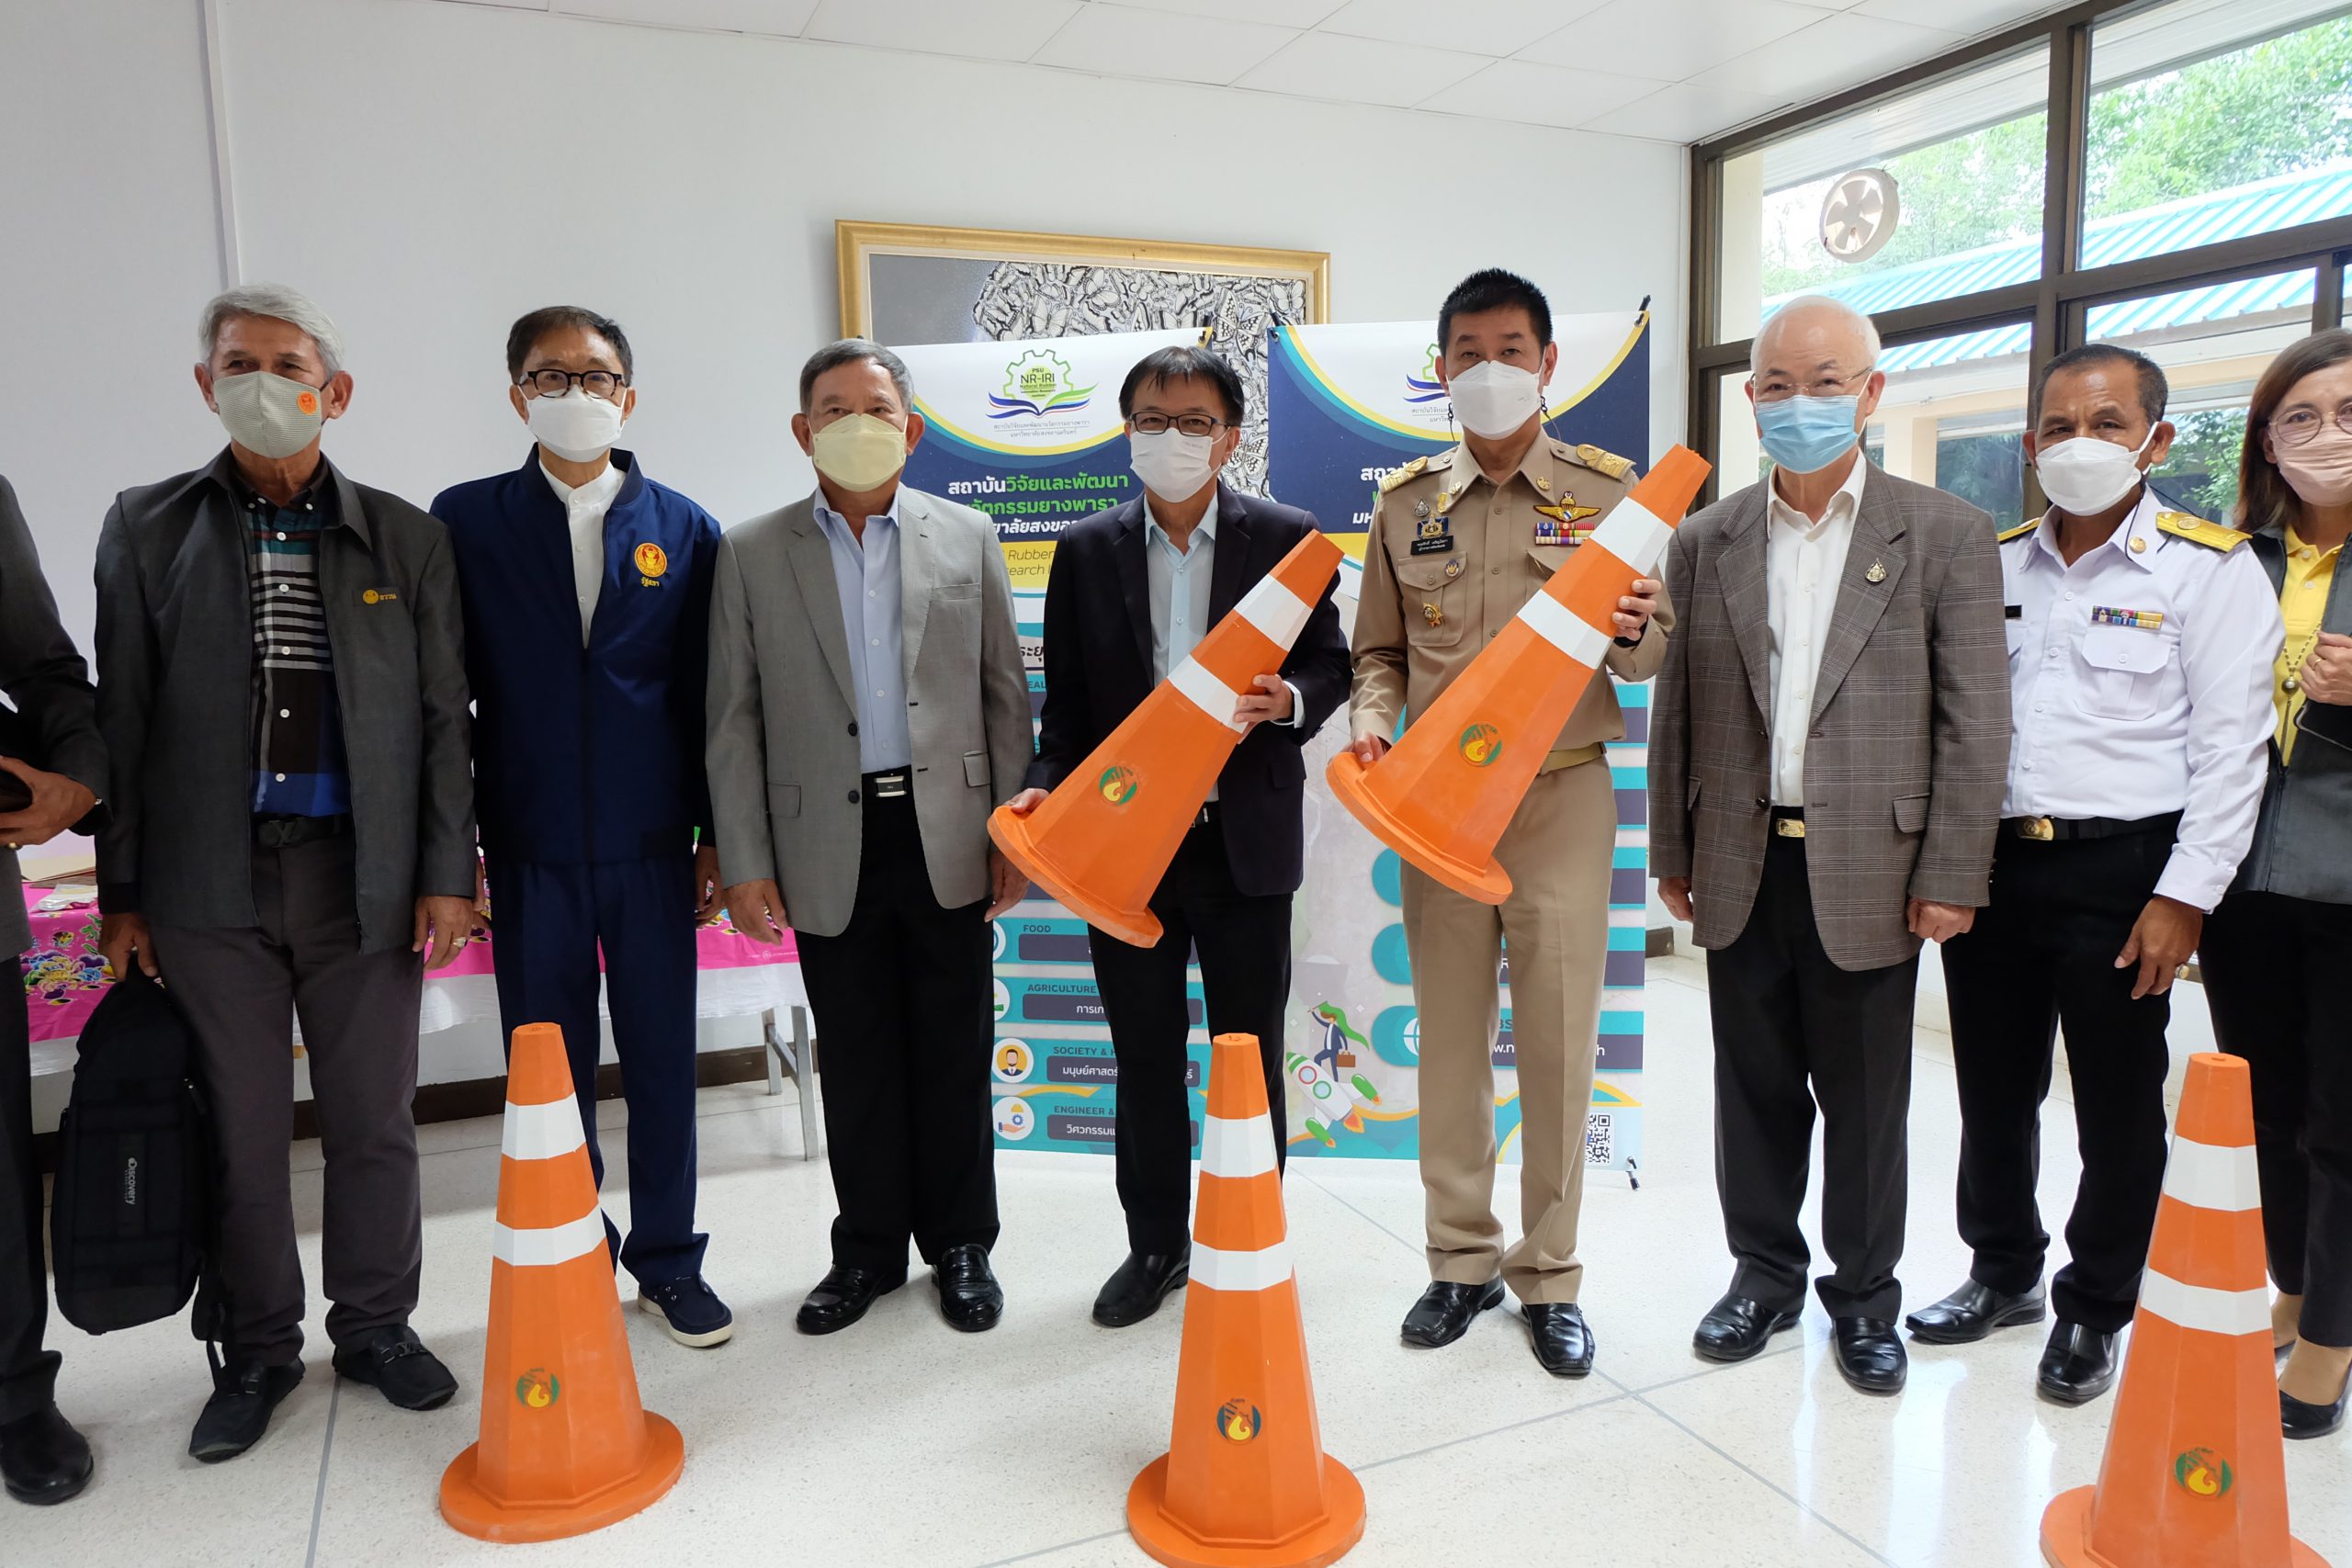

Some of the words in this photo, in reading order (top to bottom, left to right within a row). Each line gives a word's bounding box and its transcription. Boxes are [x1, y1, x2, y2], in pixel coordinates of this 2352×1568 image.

[1020, 373, 1056, 384] NR-IRI
[947, 471, 1129, 495] สถาบันวิจัยและพัฒนา
[967, 496, 1118, 515] วัตกรรมยางพารา
[1008, 547, 1054, 561] Rubber
[1007, 564, 1046, 576] earch
[1023, 924, 1051, 933] FOOD
[1027, 984, 1096, 994] AGRICULTURE
[1053, 1045, 1098, 1055] SOCIETY
[1101, 1047, 1107, 1055] &
[1054, 1105, 1105, 1115] ENGINEER
